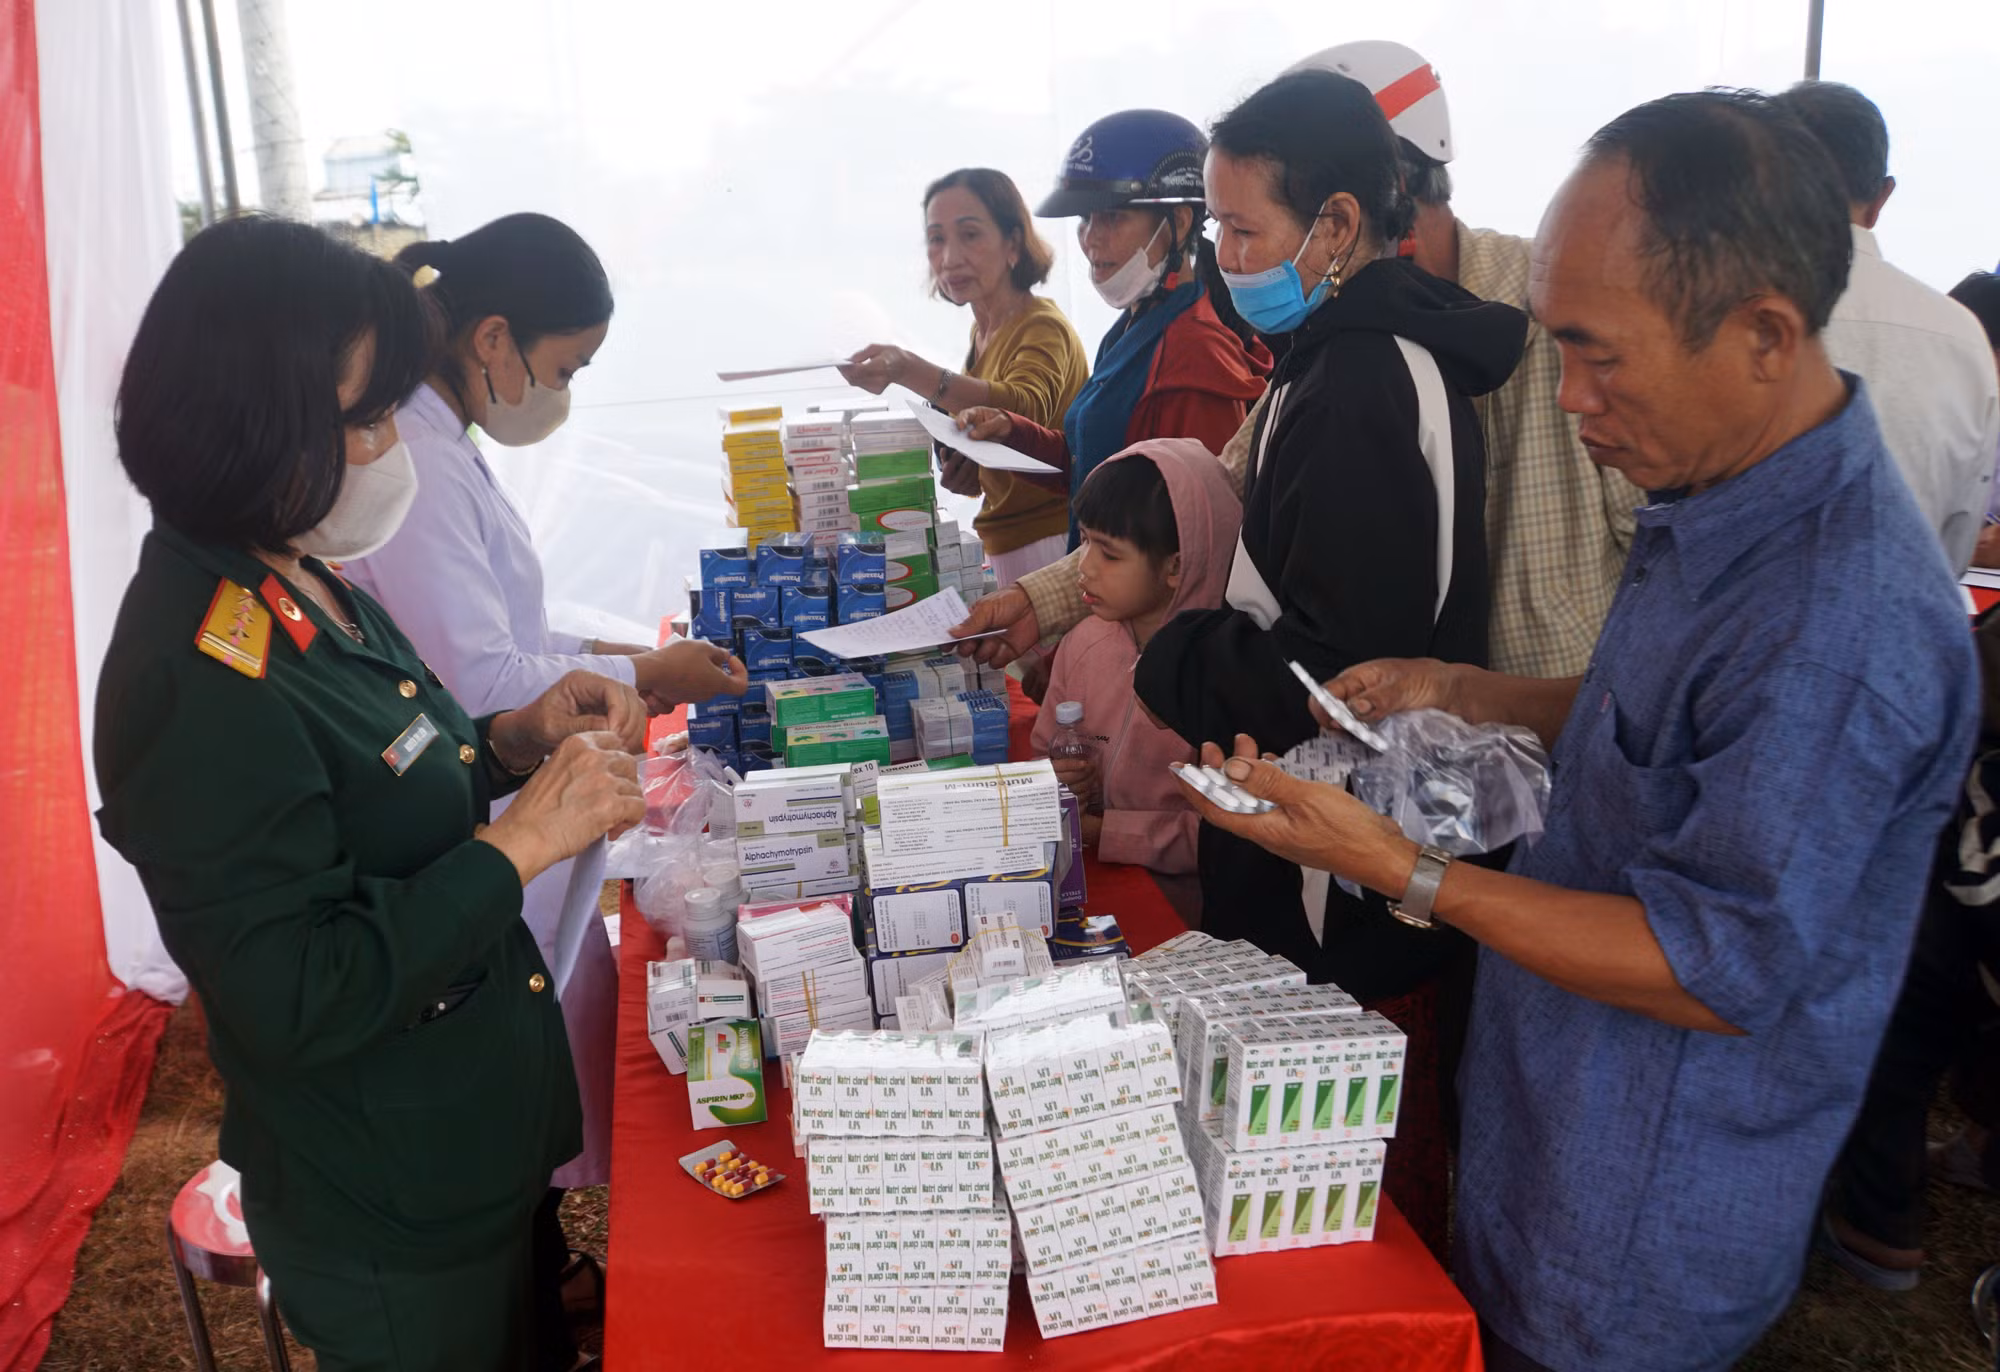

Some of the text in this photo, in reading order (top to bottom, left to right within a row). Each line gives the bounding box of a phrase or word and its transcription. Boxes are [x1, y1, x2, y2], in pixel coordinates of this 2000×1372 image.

[852, 572, 884, 580] Praxandol
[864, 762, 874, 770] 10
[768, 810, 838, 822] Alphachymotrypsin
[744, 846, 814, 862] Alphachymotrypsin
[696, 1095, 728, 1104] ASPIRIN
